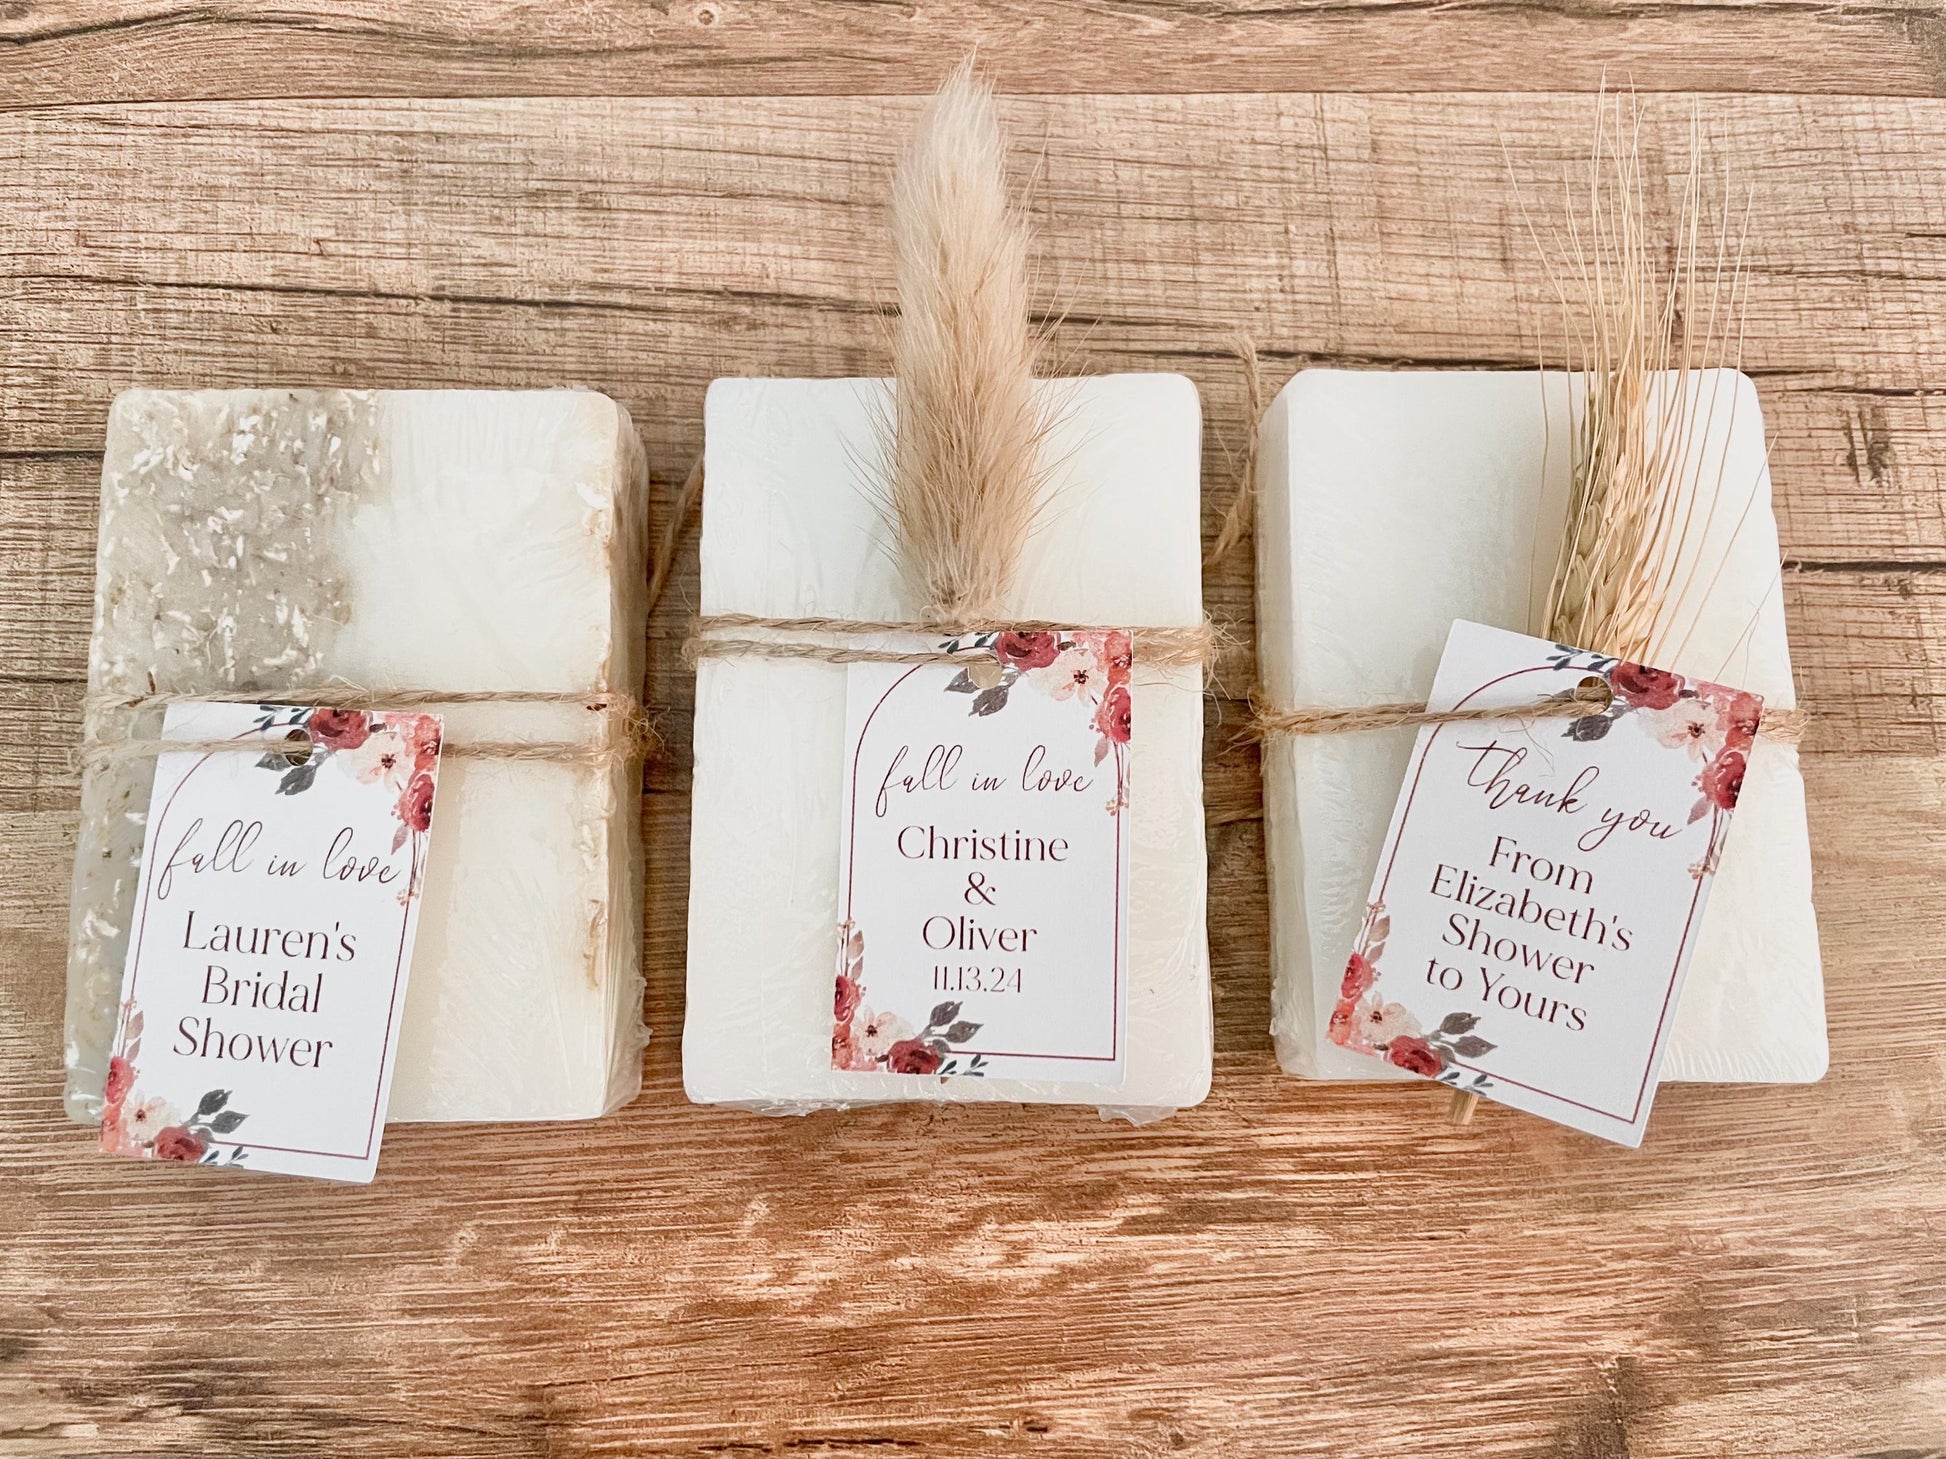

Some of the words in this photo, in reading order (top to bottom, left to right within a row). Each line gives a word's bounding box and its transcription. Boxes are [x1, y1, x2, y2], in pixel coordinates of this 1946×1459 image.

[874, 743, 963, 818] fall
[971, 770, 1008, 793] in
[1021, 743, 1095, 793] love
[1455, 739, 1600, 814] thank
[1576, 805, 1683, 852] you
[157, 817, 263, 900] fall
[266, 853, 307, 877] in
[322, 826, 402, 885] love
[896, 825, 1070, 862] Christine
[1487, 835, 1595, 895] From
[963, 871, 997, 906] &
[1429, 863, 1633, 953] Elizabeth's
[182, 909, 358, 962] Lauren's
[921, 915, 1038, 953] Oliver
[1441, 911, 1596, 986] Shower
[201, 964, 323, 1013] Bridal
[932, 965, 1023, 994] 11.13.24
[1426, 955, 1464, 991] to
[1477, 967, 1588, 1032] Yours
[172, 1015, 334, 1069] Shower
